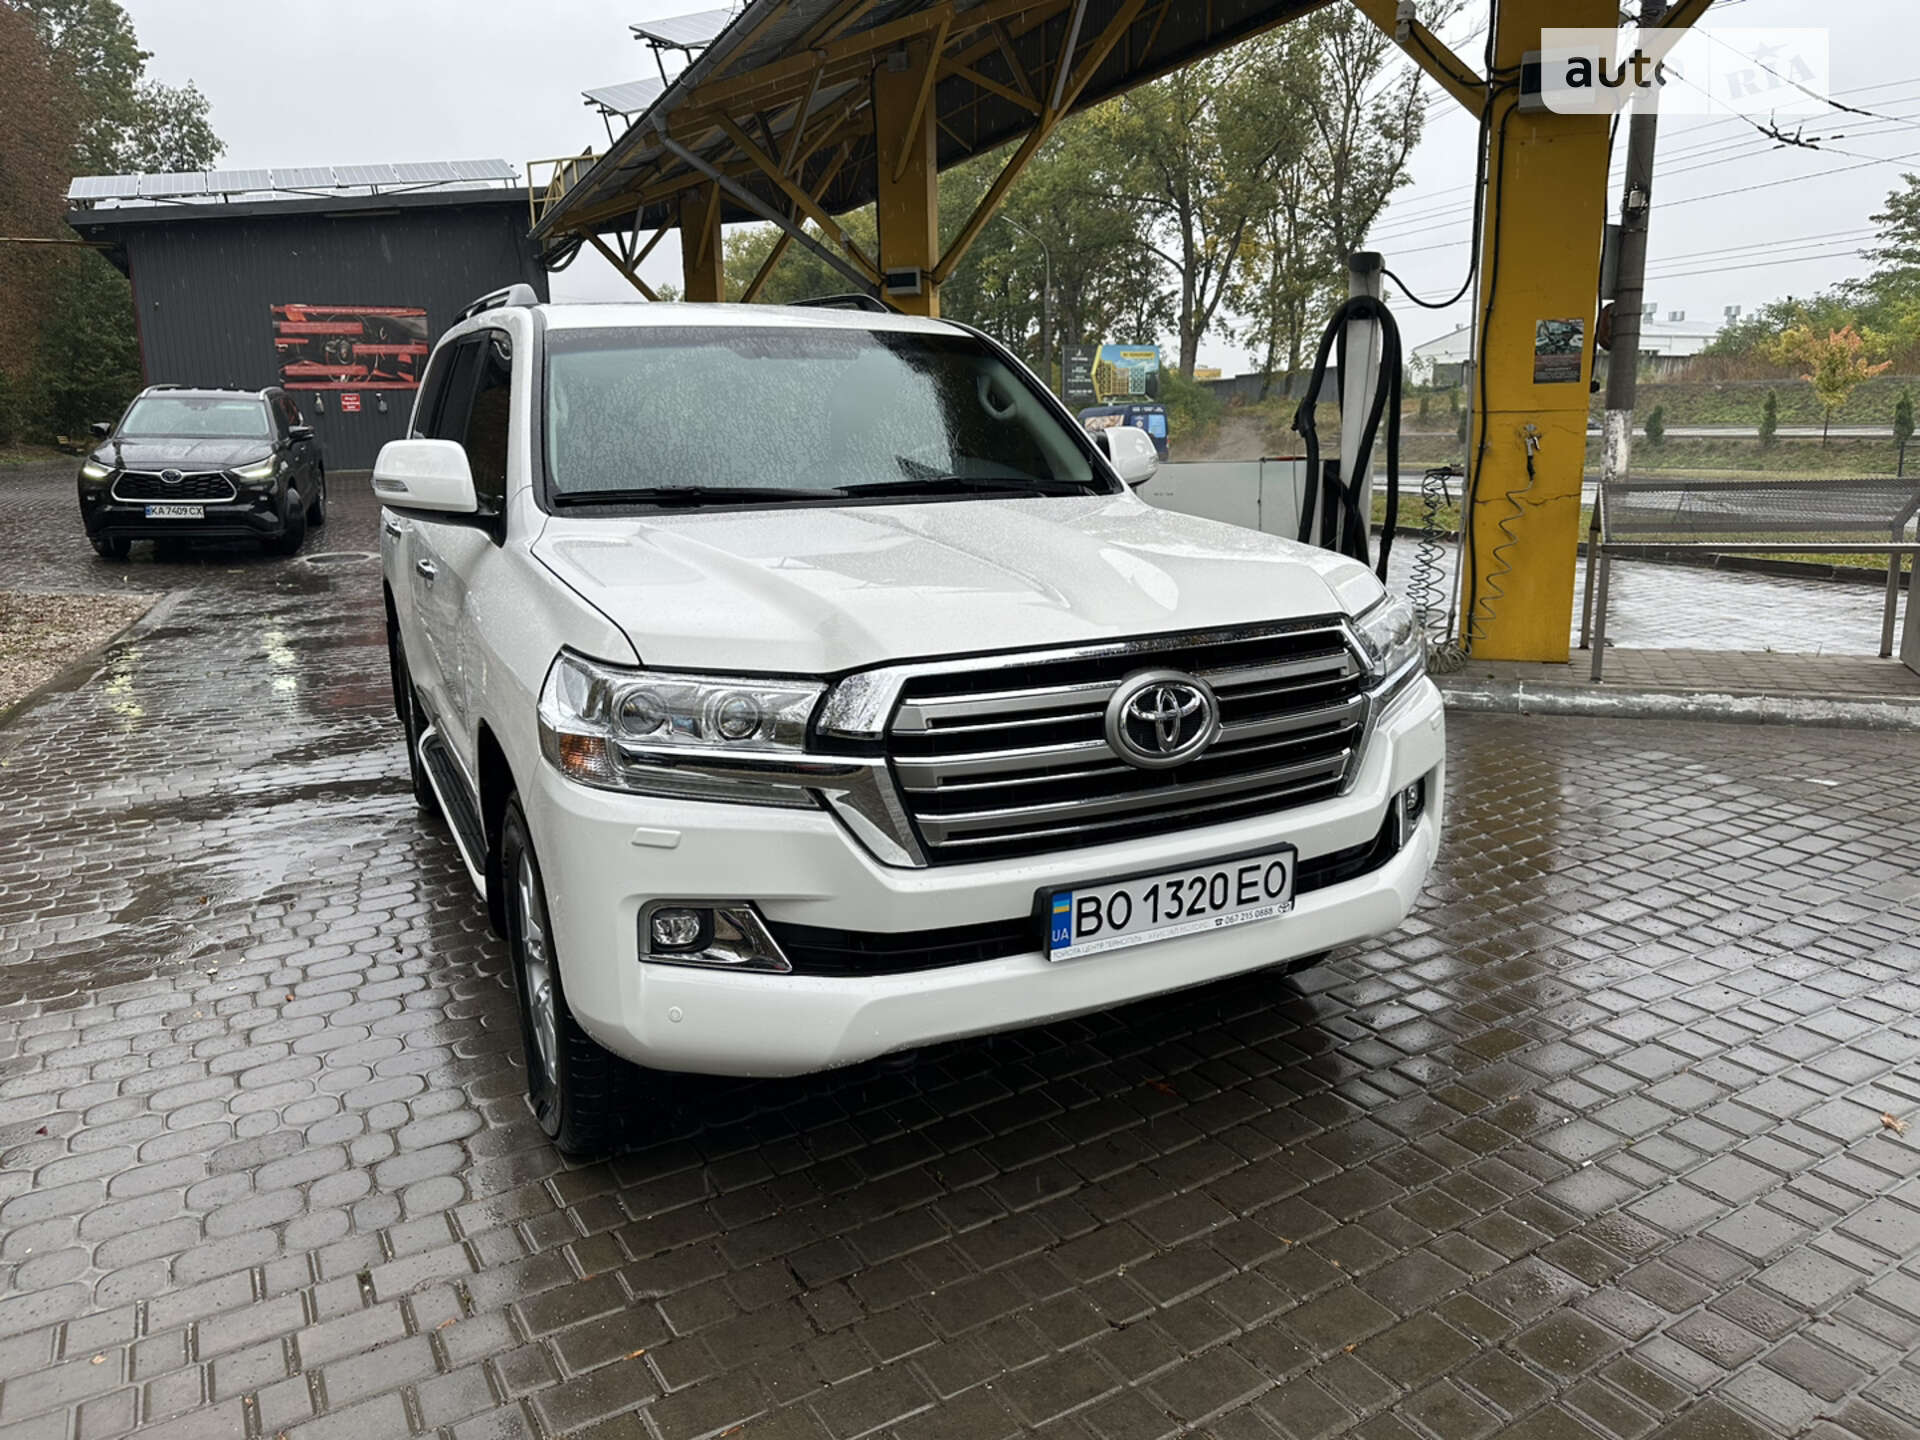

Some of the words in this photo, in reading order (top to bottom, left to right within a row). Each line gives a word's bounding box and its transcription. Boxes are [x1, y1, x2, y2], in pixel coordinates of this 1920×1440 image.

[151, 506, 165, 515] KA
[166, 506, 187, 515] 7409
[189, 506, 203, 515] CX
[1076, 890, 1132, 938] BO
[1143, 872, 1229, 923] 1320
[1237, 861, 1287, 905] EO
[1052, 928, 1069, 942] UA
